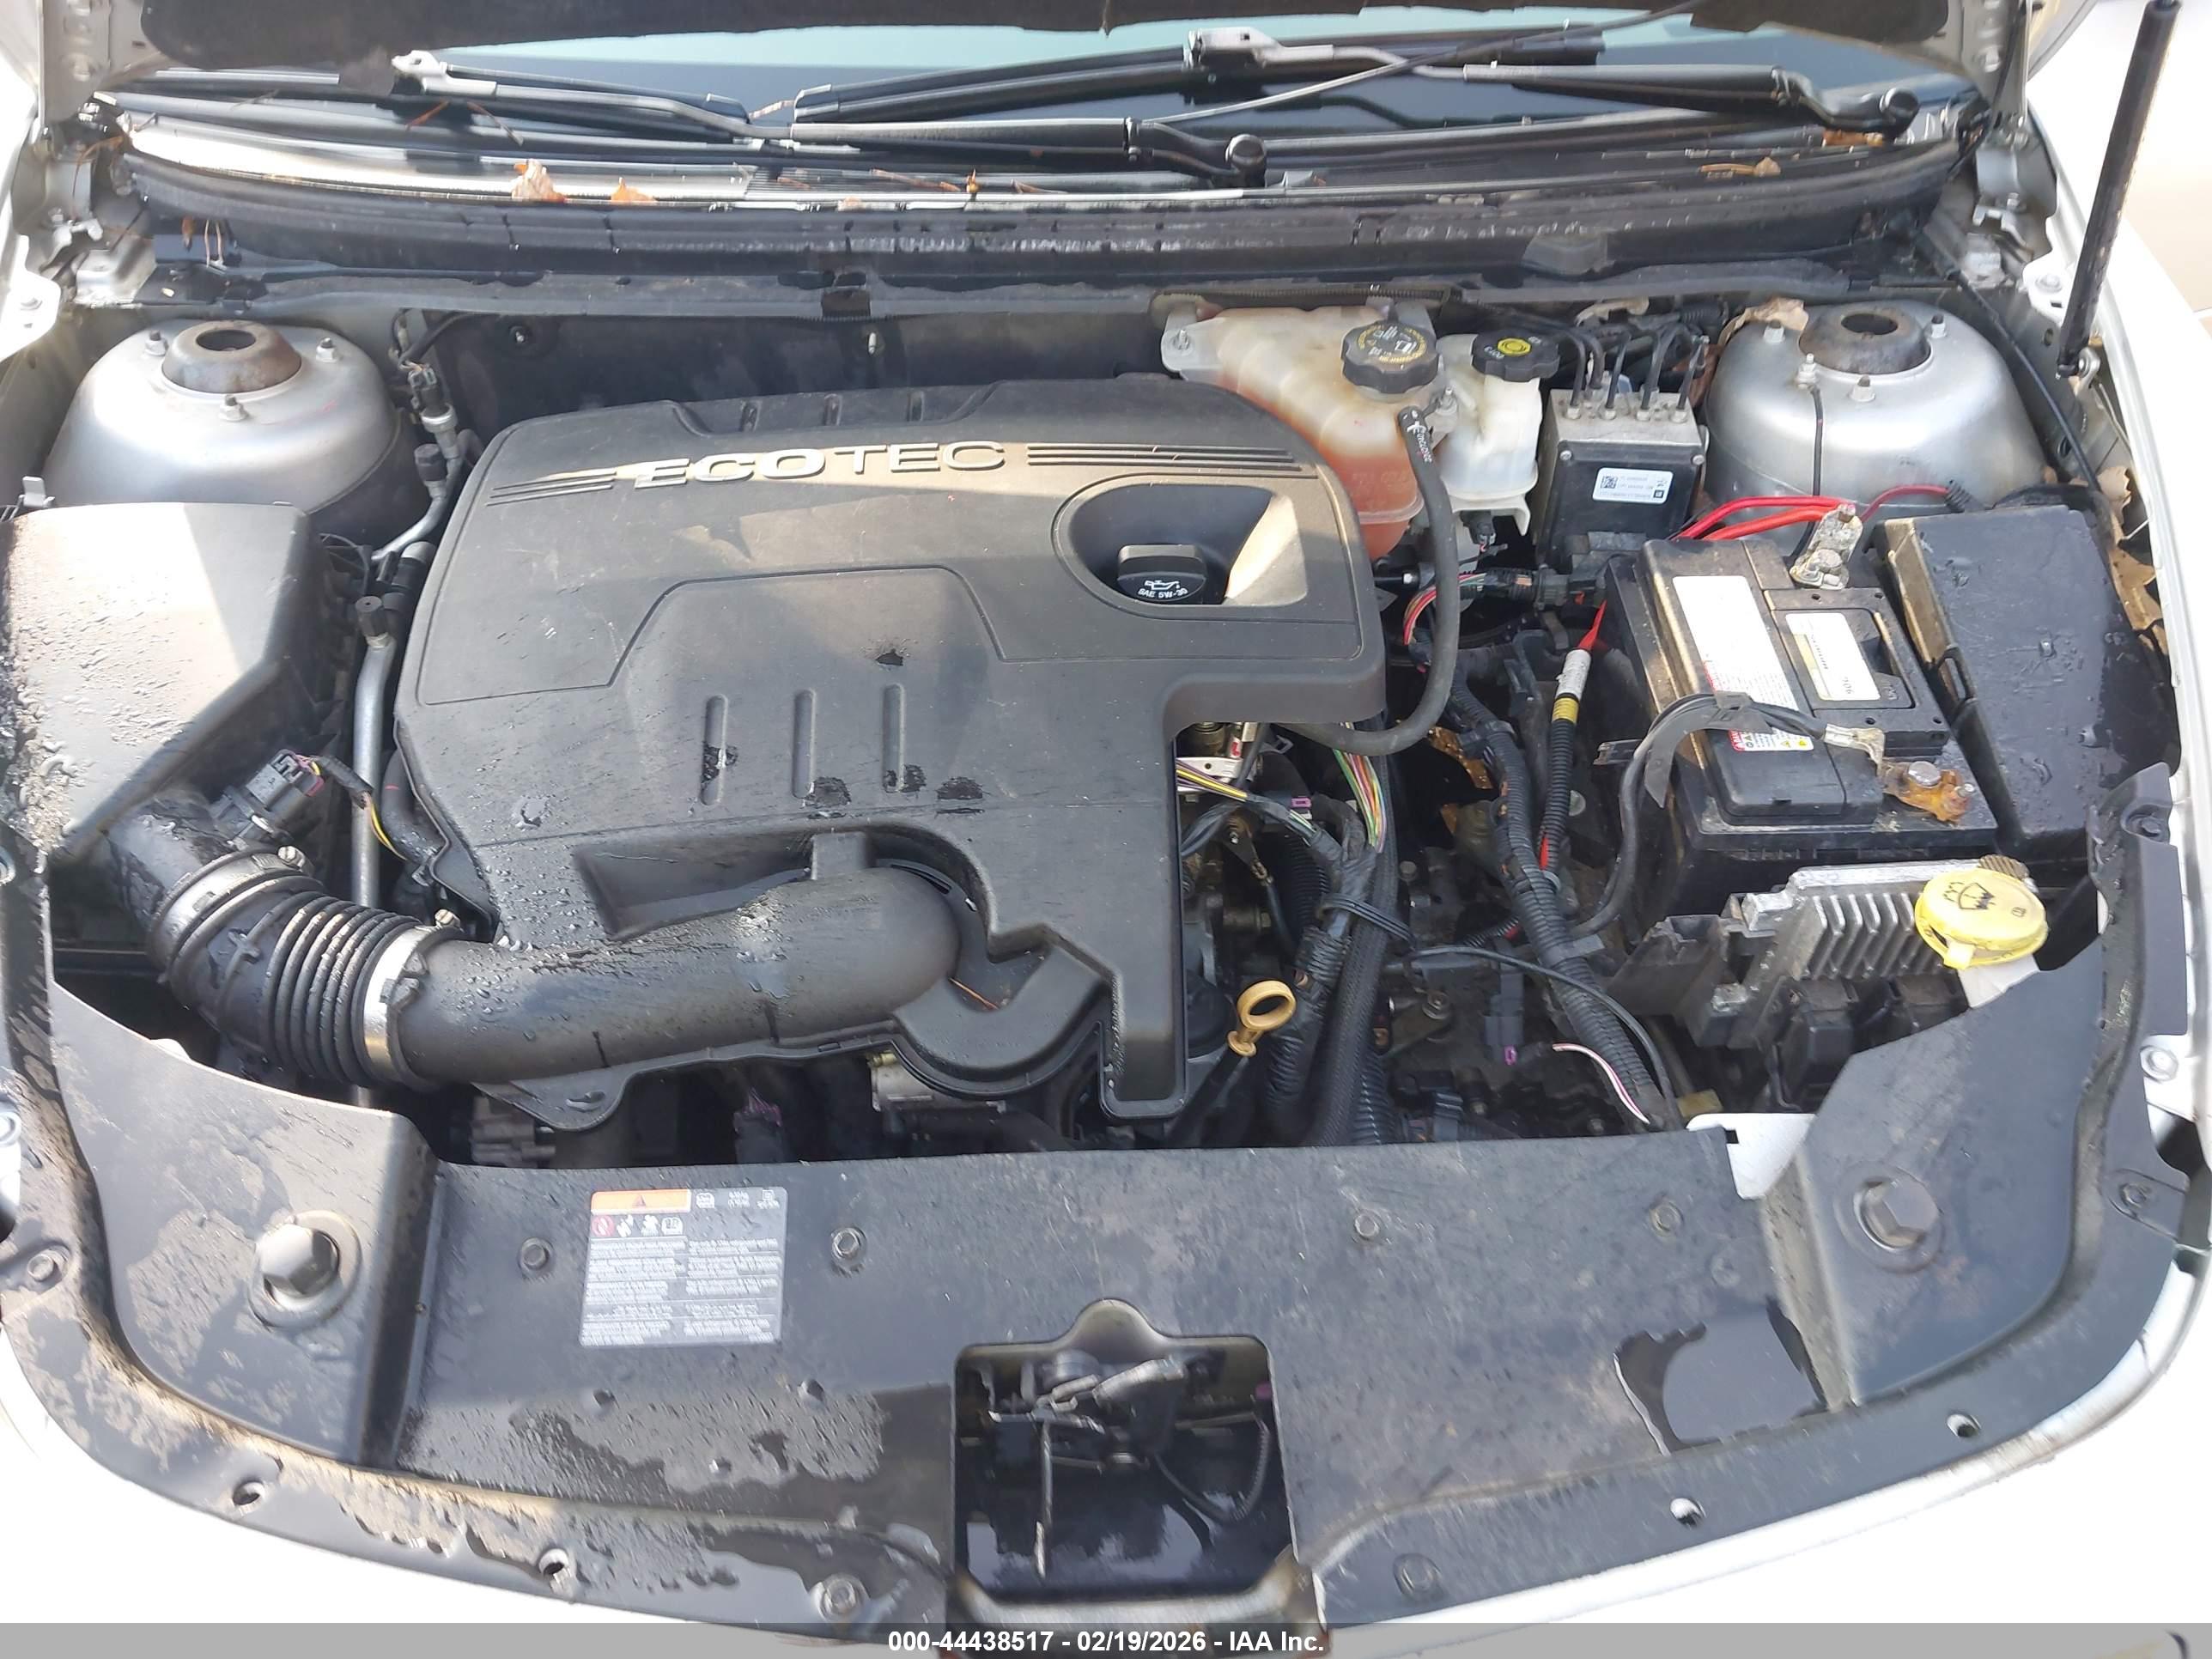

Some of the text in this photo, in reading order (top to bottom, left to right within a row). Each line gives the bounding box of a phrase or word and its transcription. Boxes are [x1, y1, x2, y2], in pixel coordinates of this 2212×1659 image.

[634, 440, 1005, 489] ECOTEC
[1138, 588, 1188, 598] SAE 5W-30
